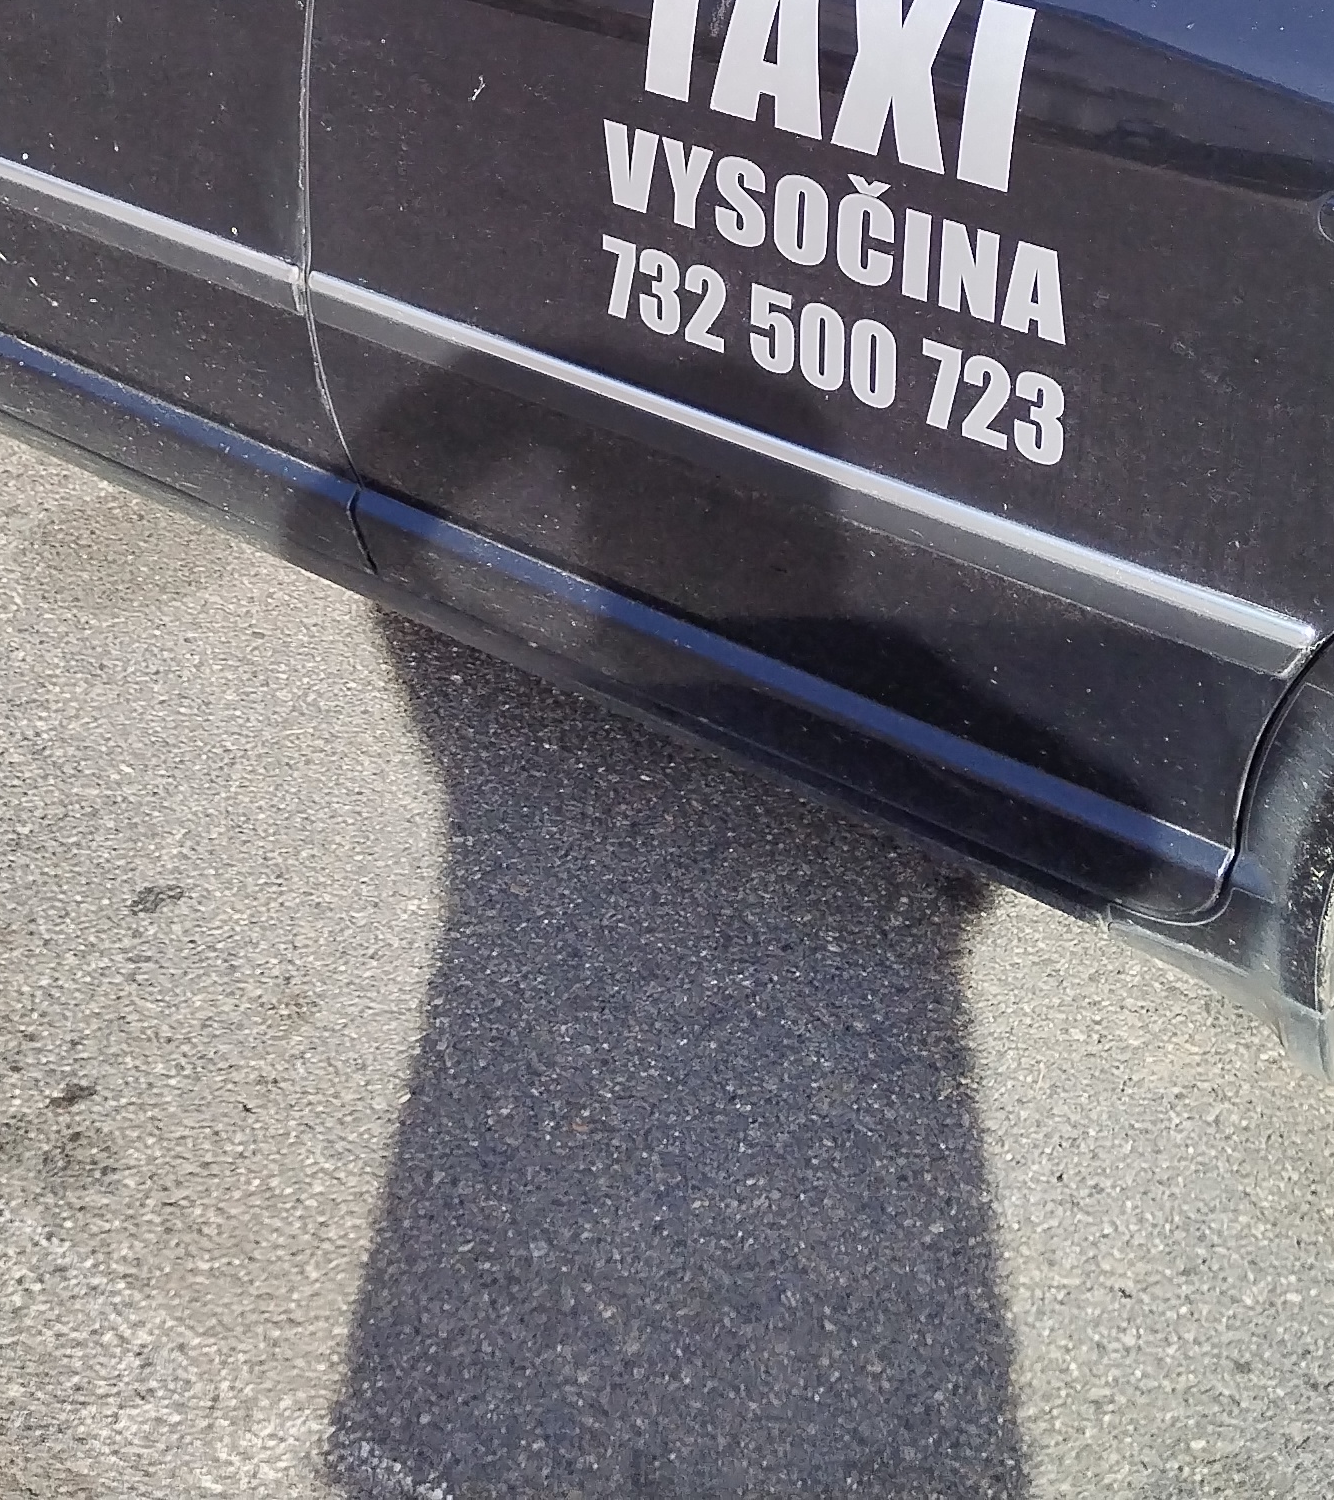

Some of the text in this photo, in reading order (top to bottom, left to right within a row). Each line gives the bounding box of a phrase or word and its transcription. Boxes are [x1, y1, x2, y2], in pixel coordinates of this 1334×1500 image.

[603, 117, 1067, 346] VYSOČINA
[601, 232, 1066, 466] 732 500 723
